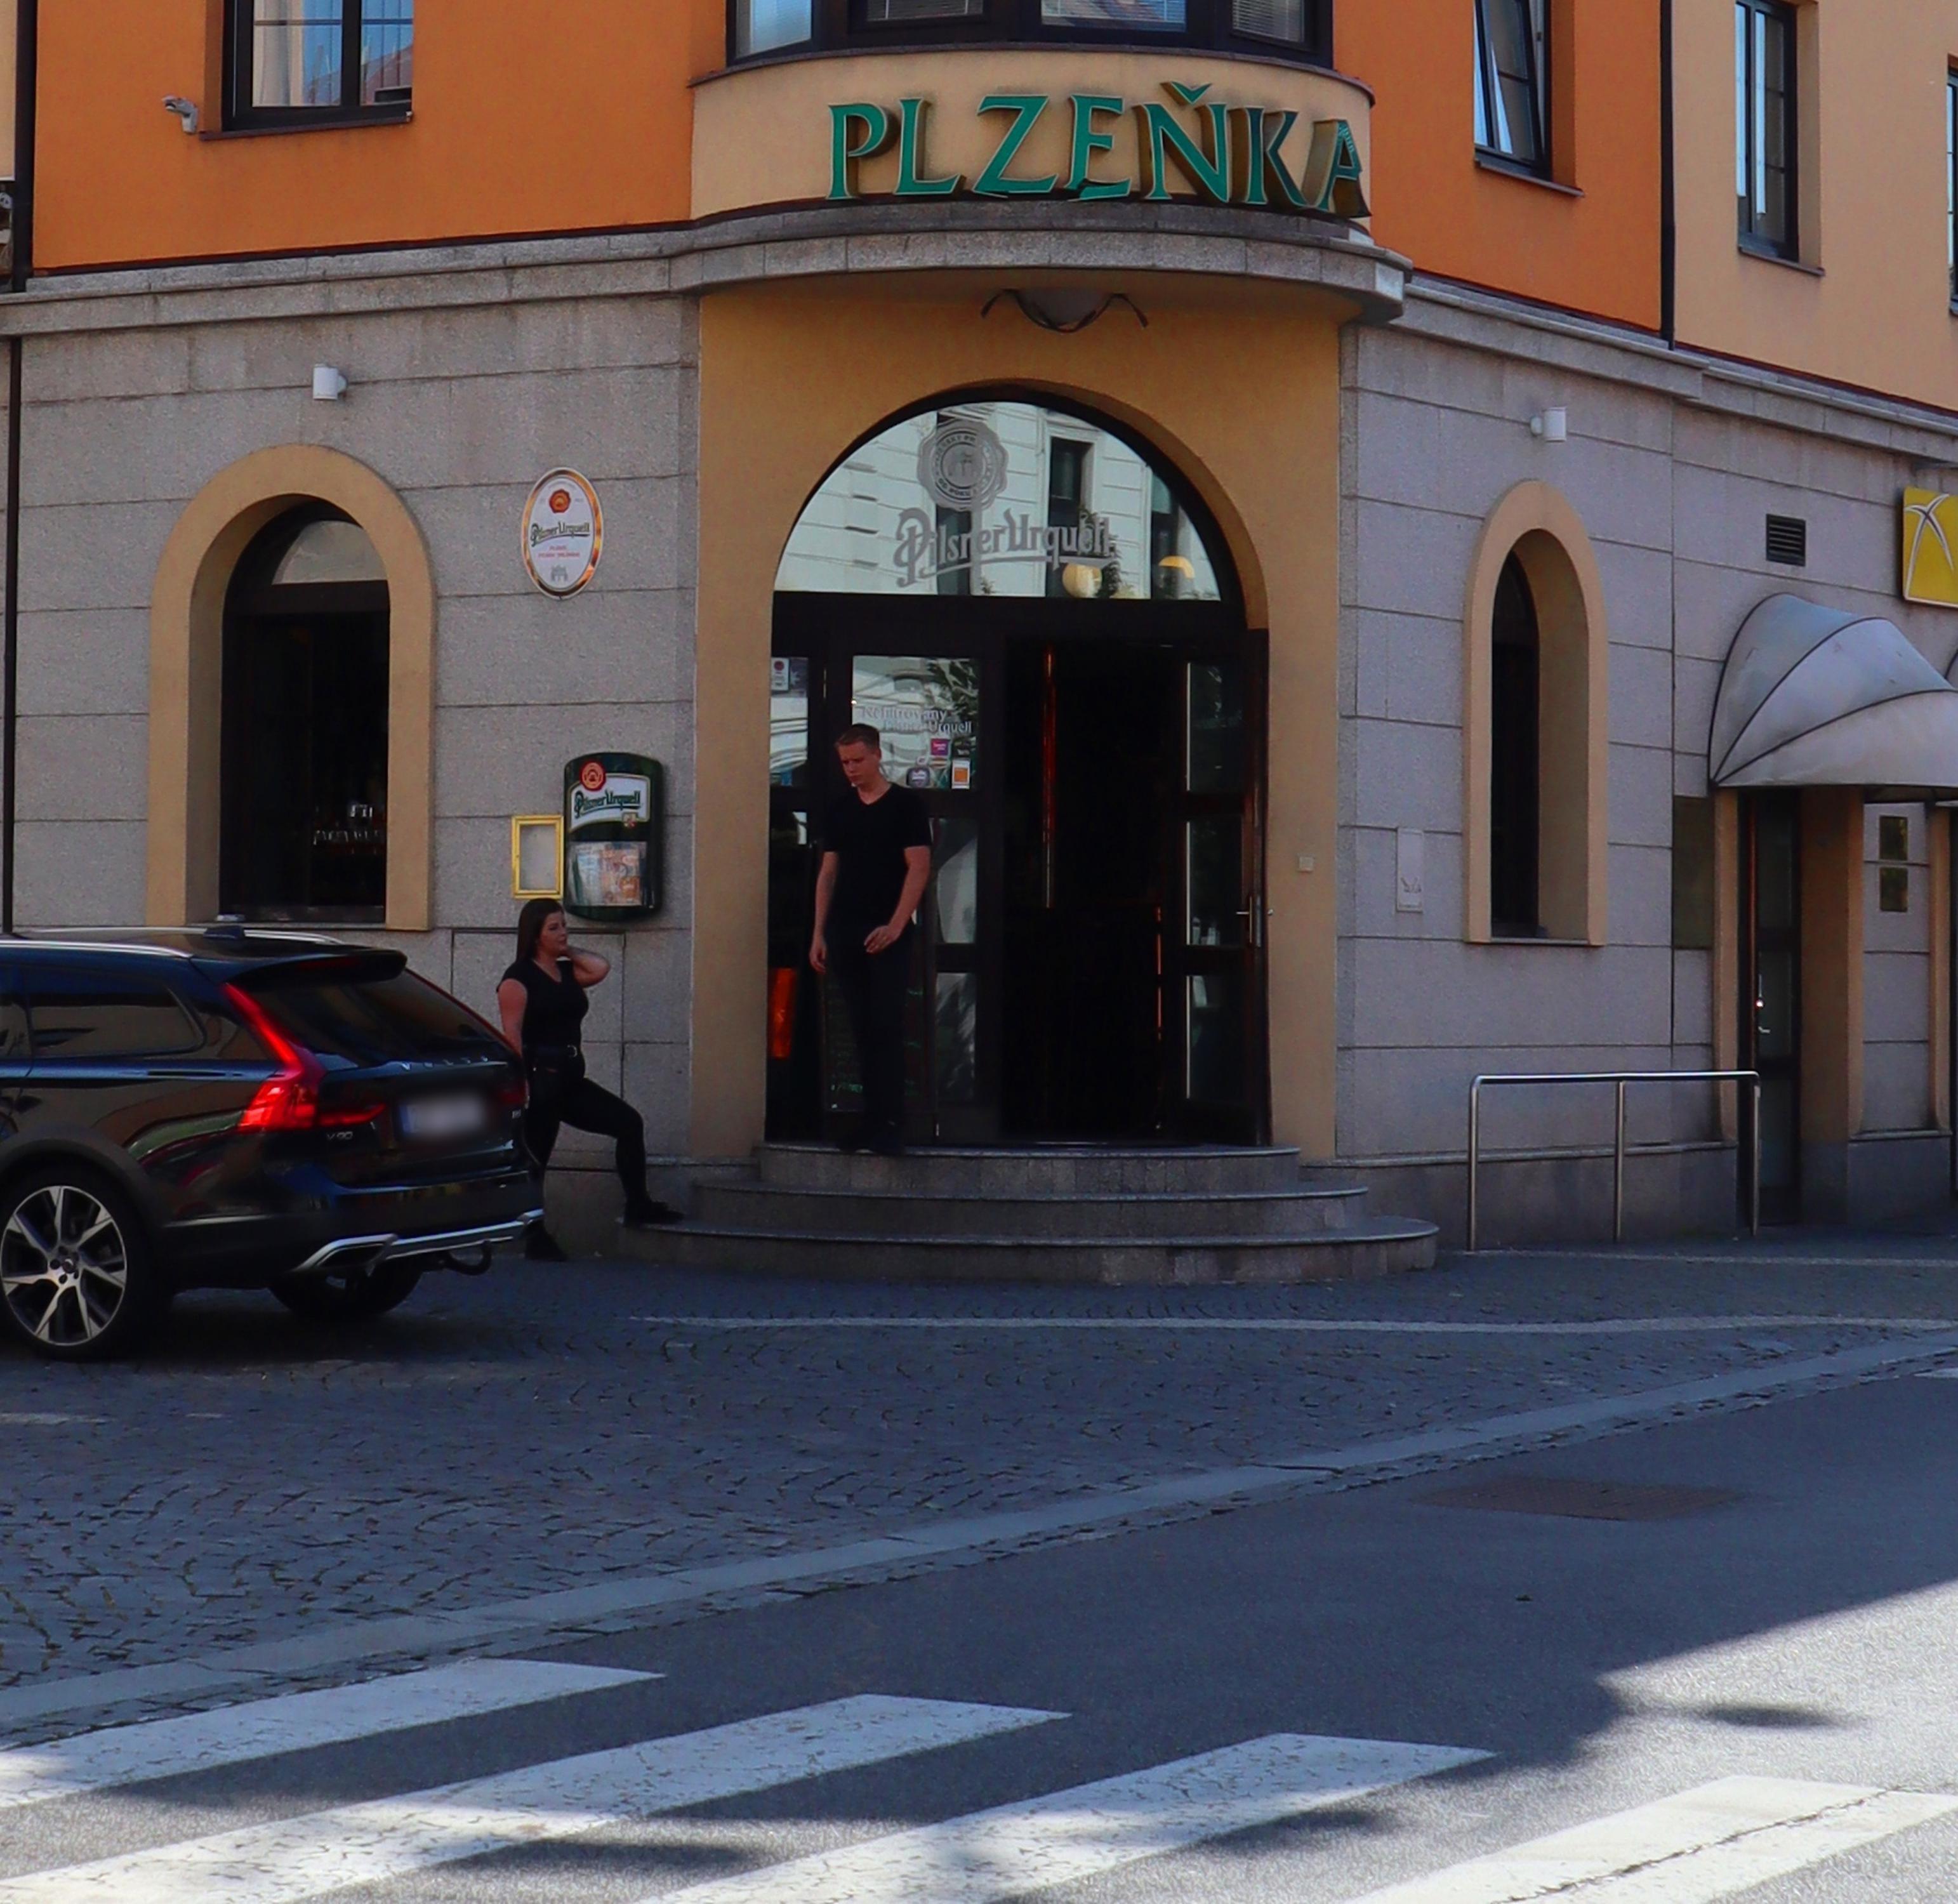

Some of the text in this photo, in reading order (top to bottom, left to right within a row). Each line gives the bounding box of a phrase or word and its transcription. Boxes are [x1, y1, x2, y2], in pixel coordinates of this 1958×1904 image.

[826, 81, 1371, 216] PLZEŇKA
[894, 508, 1111, 588] Pilsner Urquell
